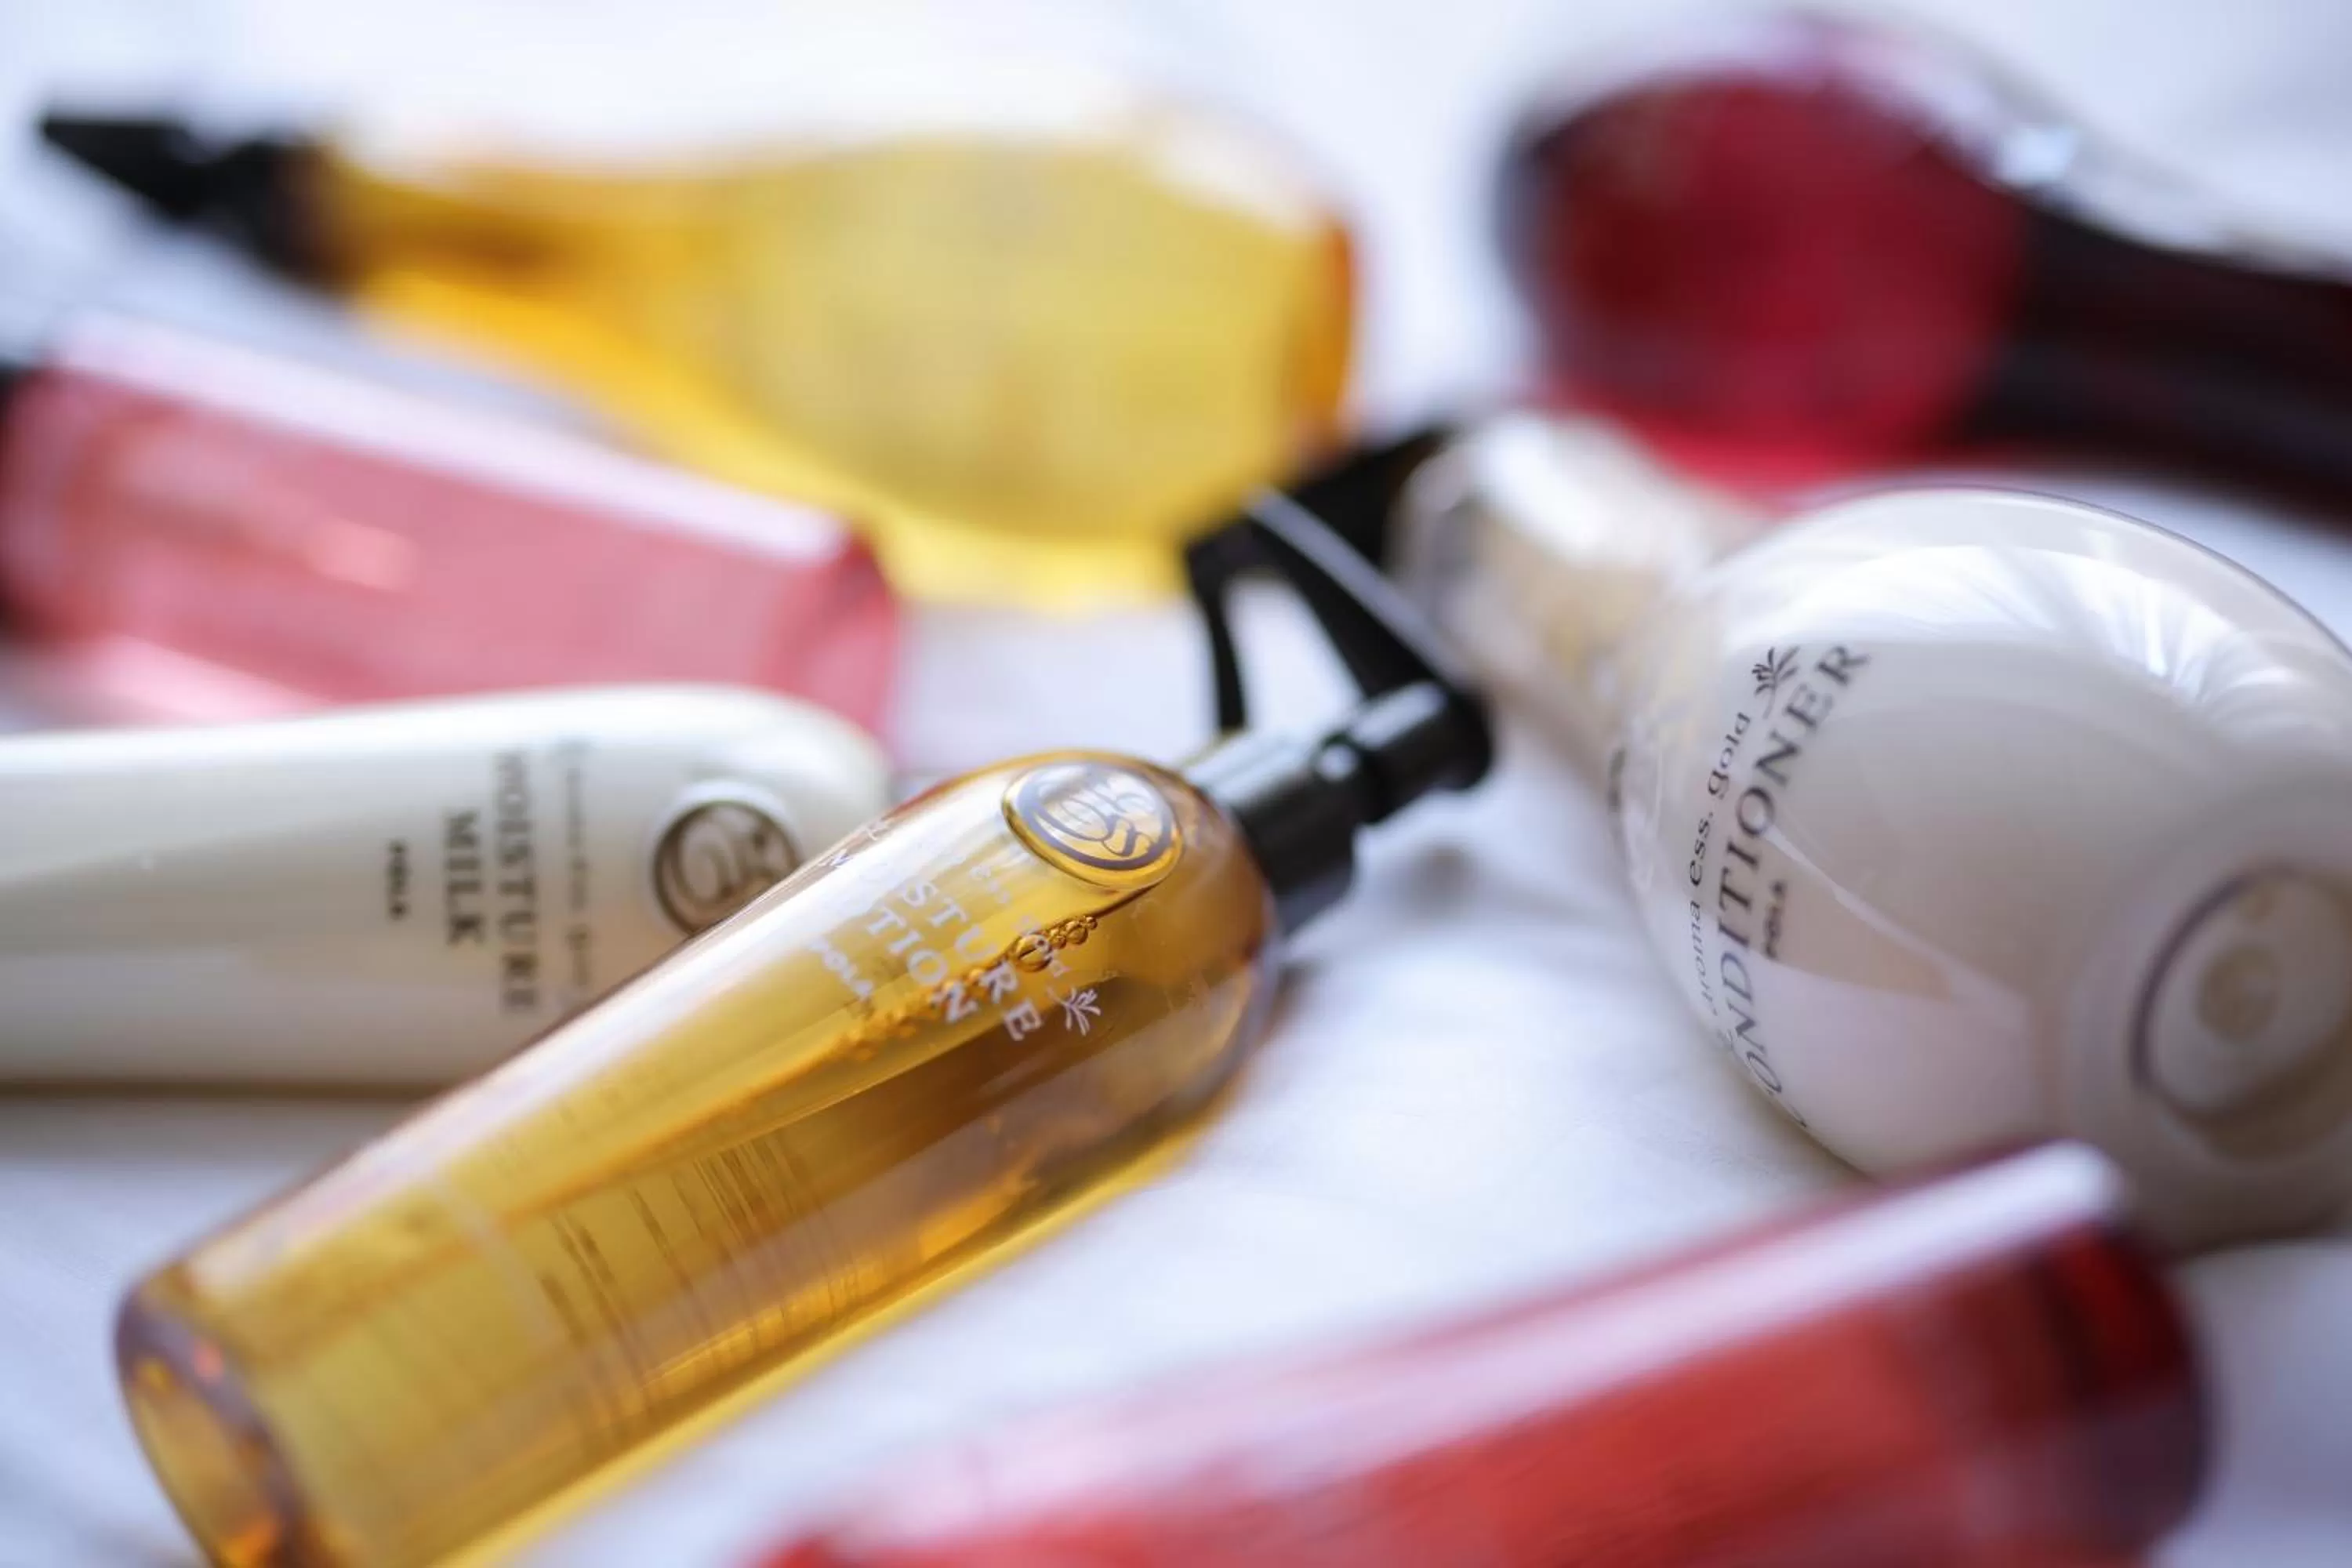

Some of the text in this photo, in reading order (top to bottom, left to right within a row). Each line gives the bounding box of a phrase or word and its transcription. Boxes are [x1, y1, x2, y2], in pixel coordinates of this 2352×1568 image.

[1707, 711, 1751, 801] gold
[445, 808, 486, 946] MILK
[1715, 644, 1872, 1129] ONDITIONER
